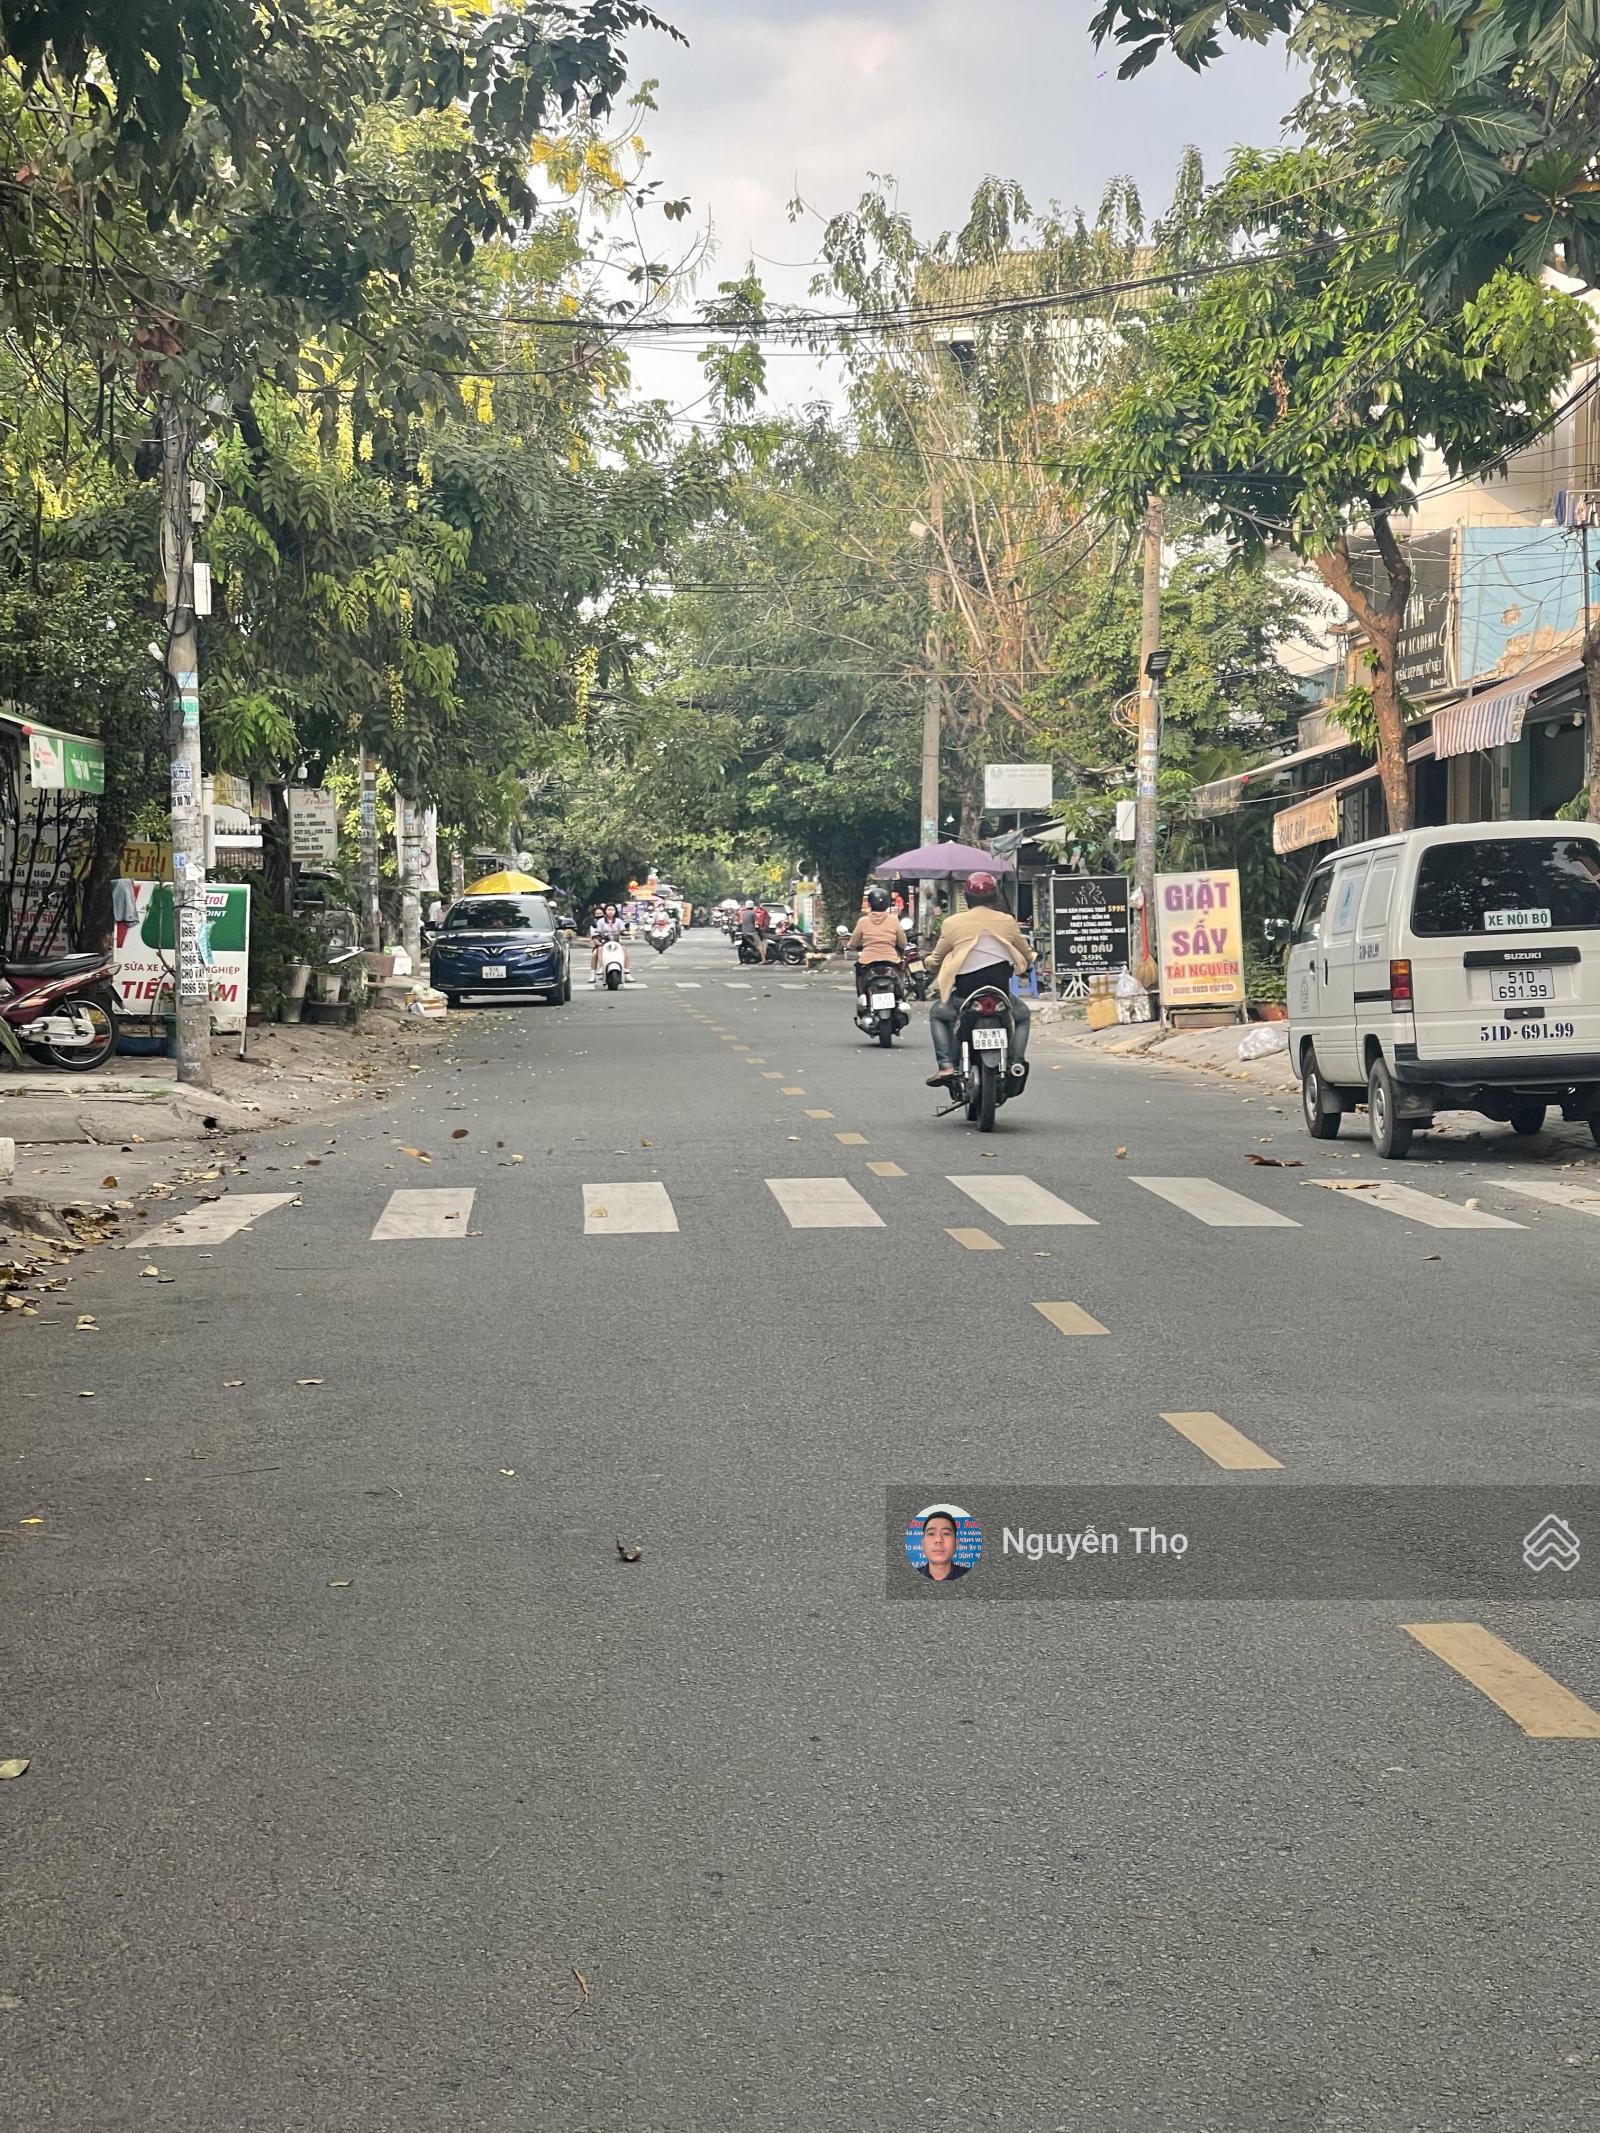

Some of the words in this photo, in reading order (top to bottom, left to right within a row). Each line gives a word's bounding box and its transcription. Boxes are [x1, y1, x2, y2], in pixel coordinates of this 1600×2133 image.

[1408, 631, 1438, 656] ACADEMY
[1165, 878, 1231, 914] GIẶT
[1488, 914, 1503, 926] XE
[1507, 912, 1528, 927] NỘI
[1532, 912, 1549, 926] BỘ
[1172, 919, 1228, 957] SẤY
[1504, 952, 1541, 960] SUZUKI
[124, 961, 144, 971] SỬA
[1166, 963, 1186, 980] TÀI
[1188, 960, 1239, 977] NGUYÊN
[1508, 971, 1534, 984] 51D
[122, 976, 176, 1000] TI
[1499, 984, 1547, 999] 691.99
